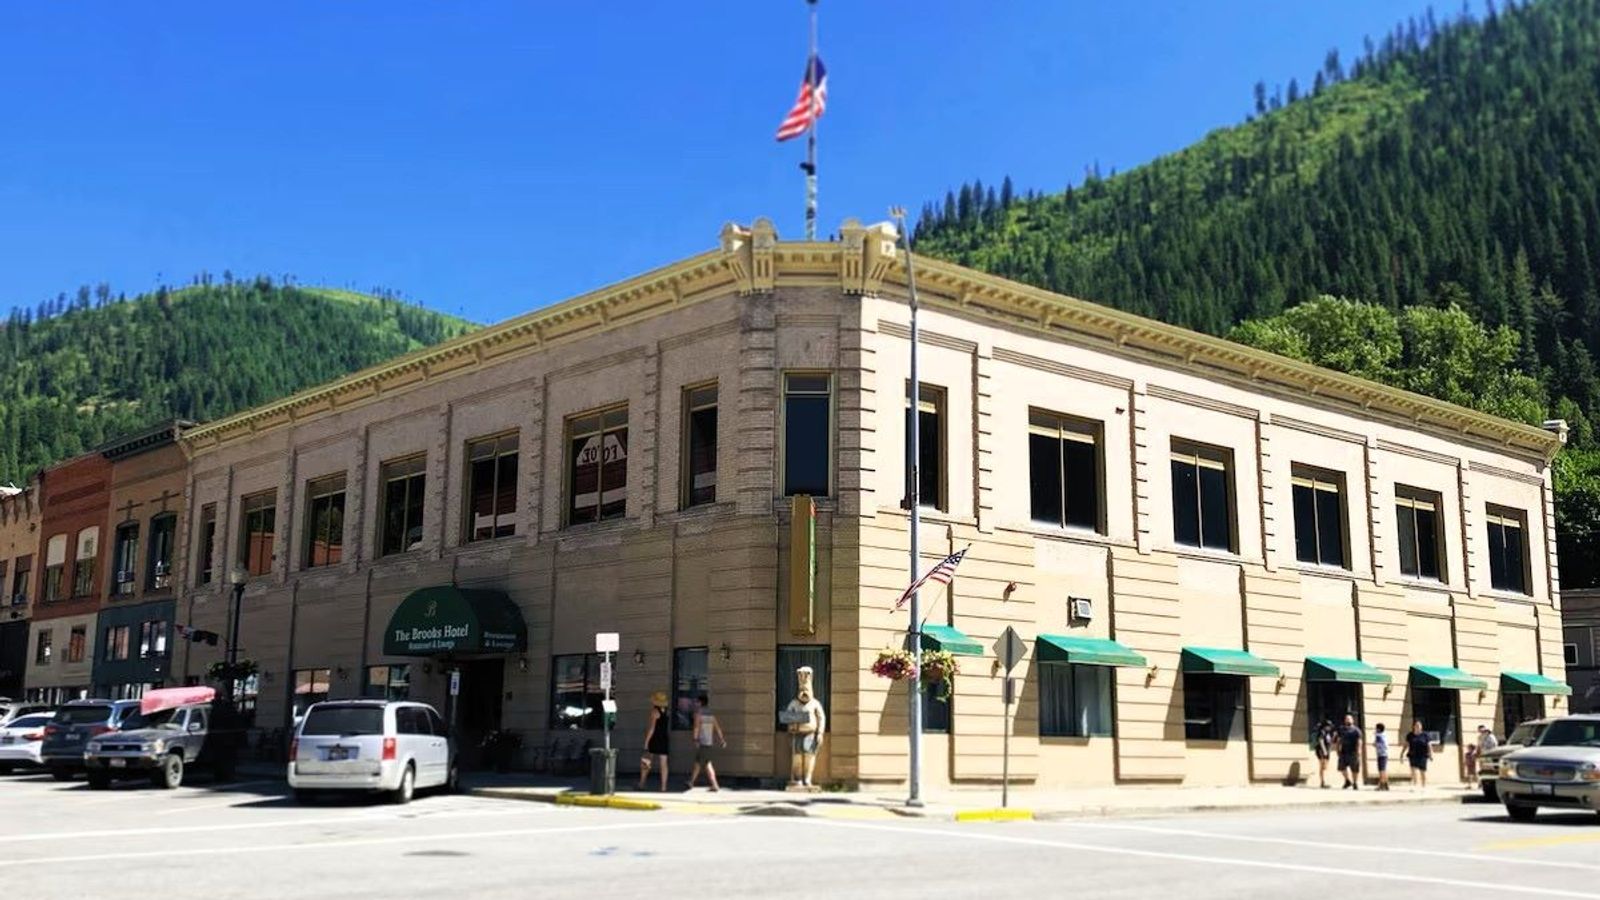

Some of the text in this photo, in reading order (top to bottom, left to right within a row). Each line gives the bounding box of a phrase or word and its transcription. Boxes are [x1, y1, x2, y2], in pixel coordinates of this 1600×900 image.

[395, 629, 411, 642] The
[411, 626, 442, 640] Brooks
[444, 623, 469, 638] Hotel
